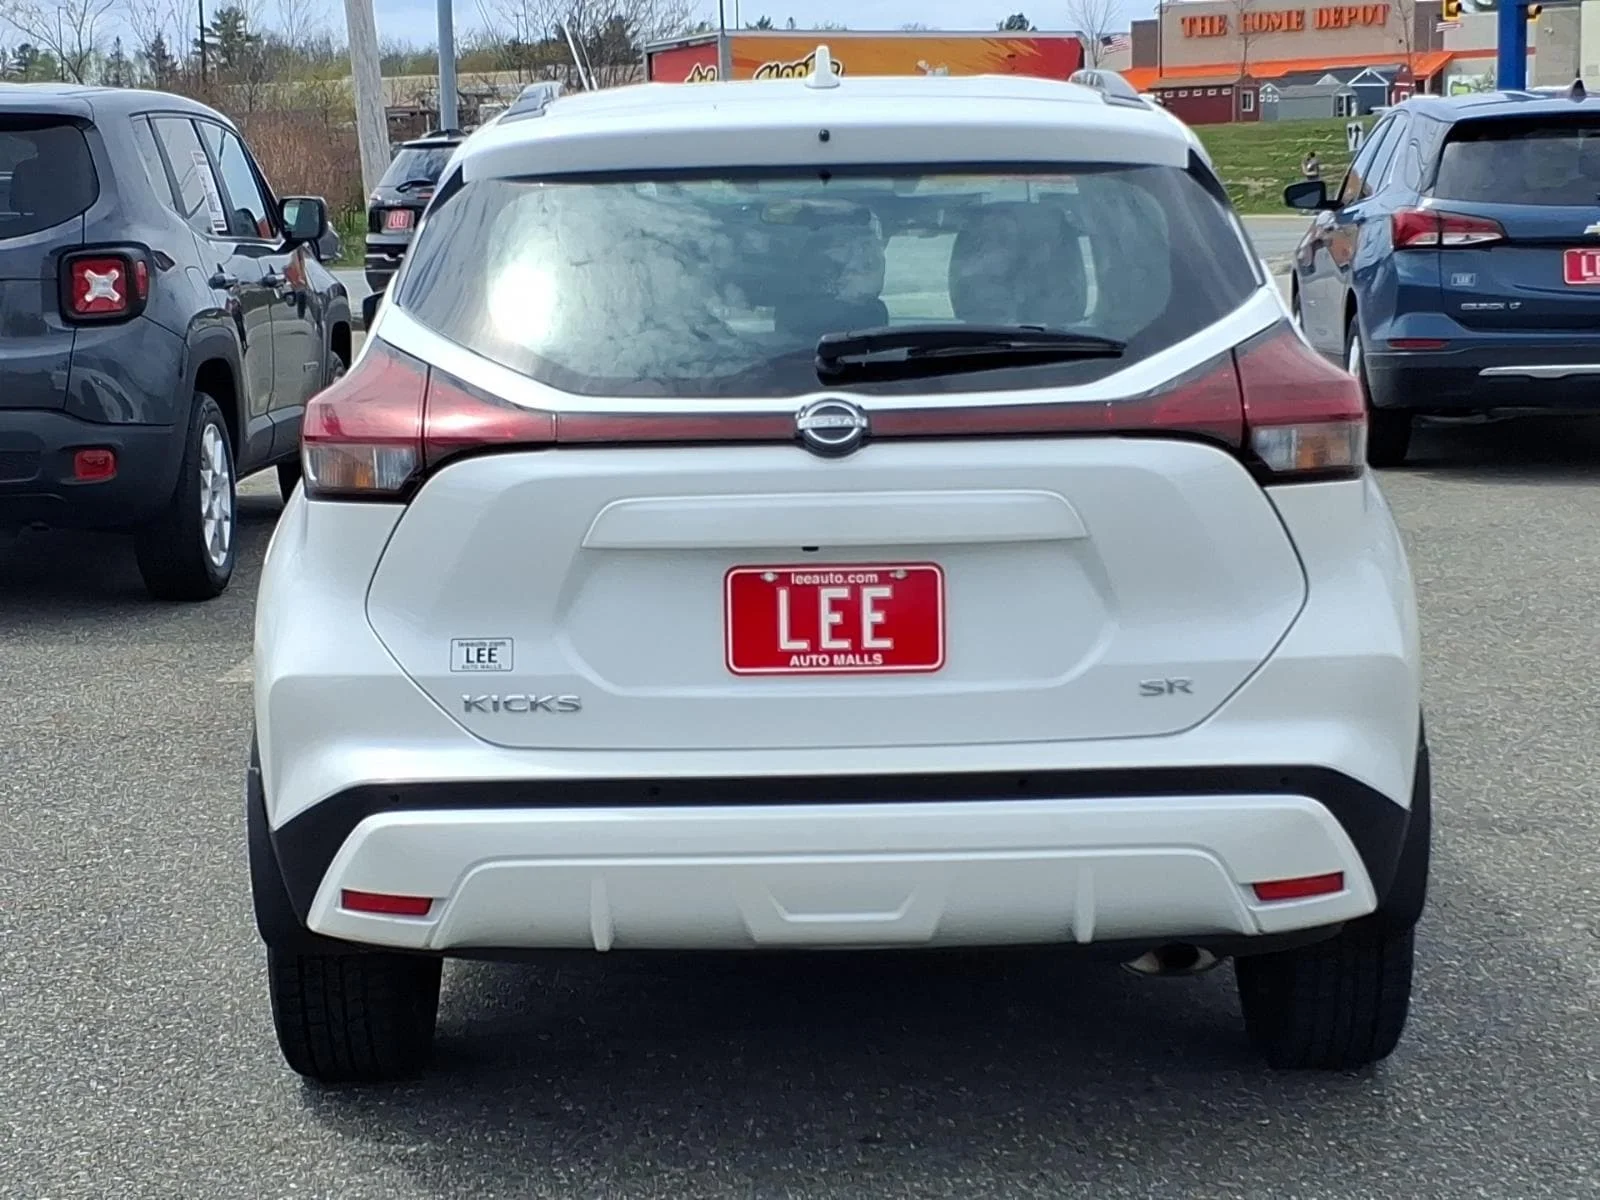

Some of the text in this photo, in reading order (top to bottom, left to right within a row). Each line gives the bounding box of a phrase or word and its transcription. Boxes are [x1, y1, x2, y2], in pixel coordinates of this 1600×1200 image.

[1181, 4, 1390, 38] THE HOME DEPOT
[790, 572, 878, 585] leeauto.com
[776, 585, 894, 652] LEE
[466, 647, 498, 664] LEE
[789, 653, 883, 667] AUTO MALLS
[1139, 677, 1194, 697] SR
[462, 693, 582, 713] KICKS
